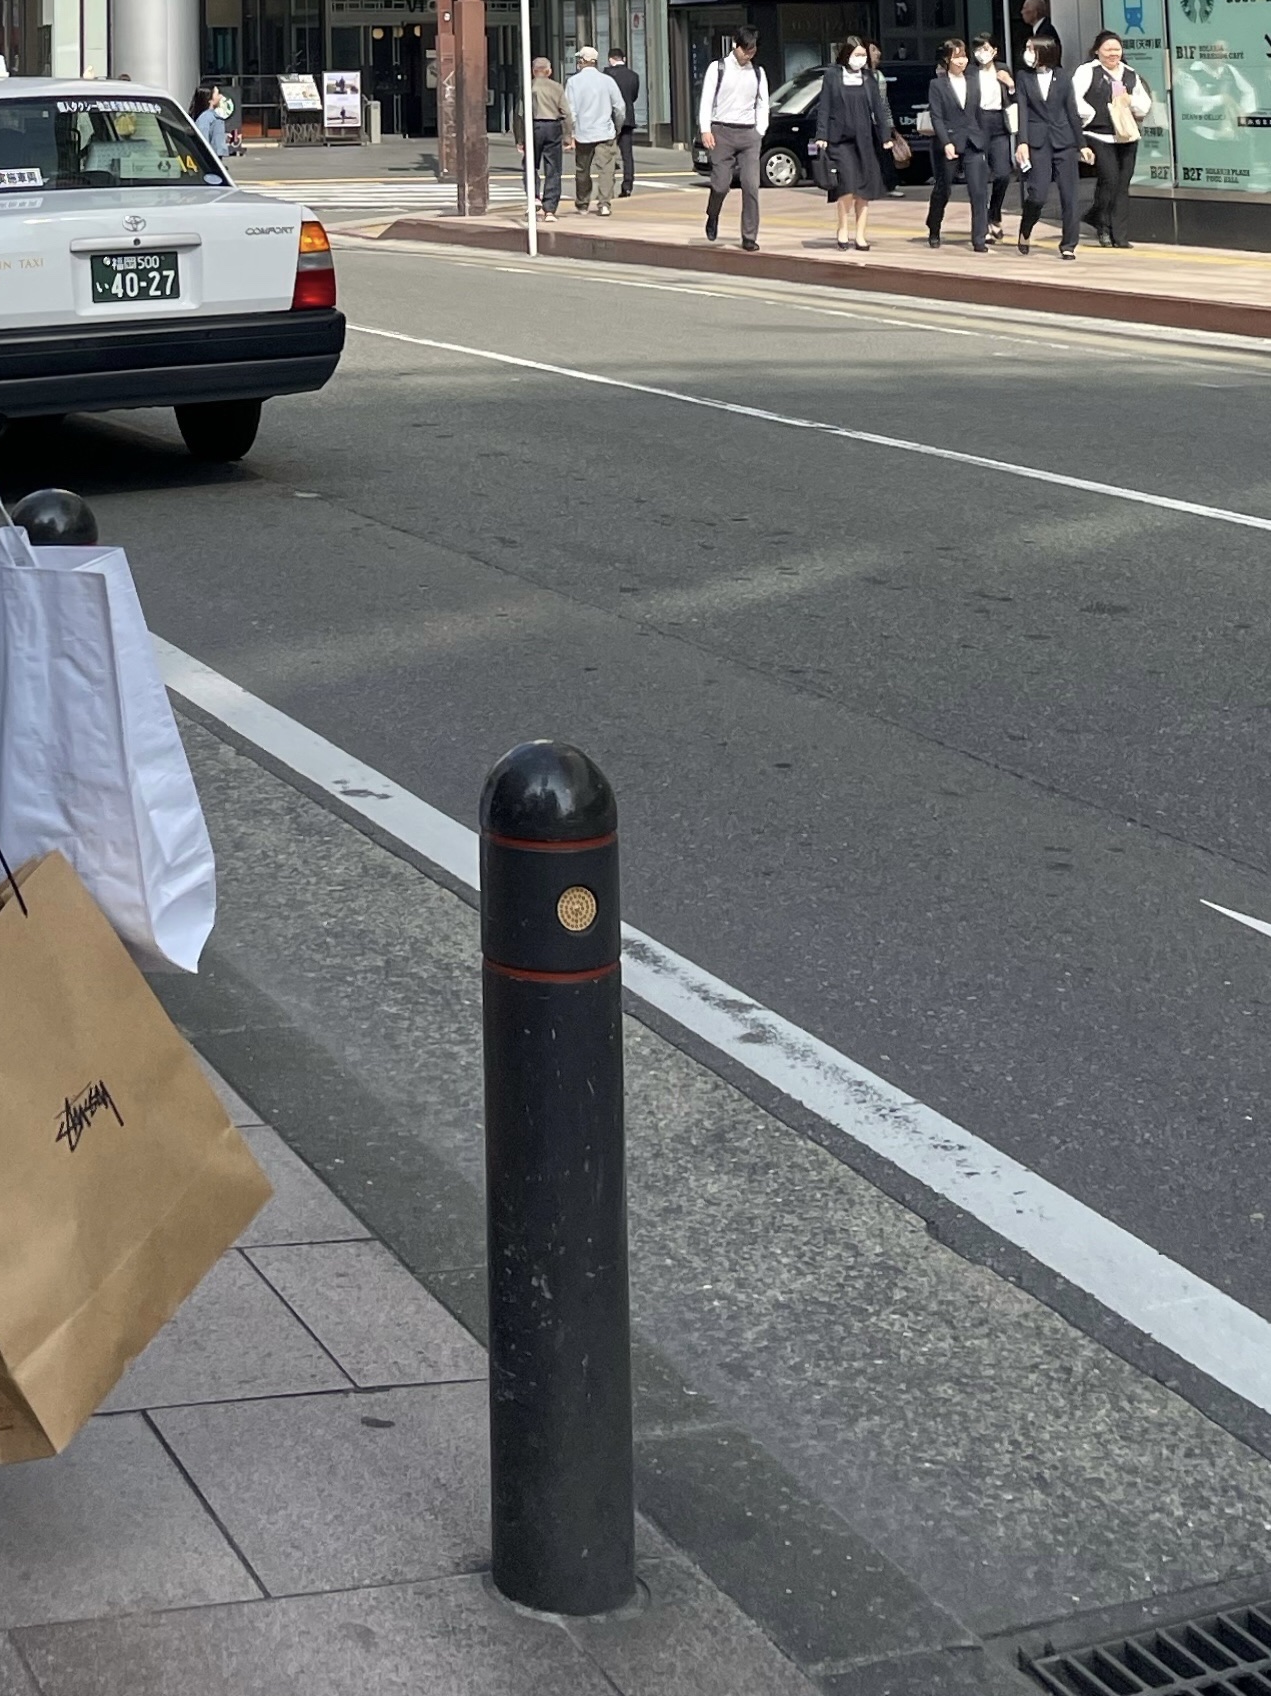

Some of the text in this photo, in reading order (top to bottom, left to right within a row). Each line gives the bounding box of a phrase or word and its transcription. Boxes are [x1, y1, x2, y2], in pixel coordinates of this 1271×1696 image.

[1176, 45, 1196, 60] B1F
[1182, 166, 1203, 182] B2F
[245, 226, 296, 236] COMFORT
[19, 258, 45, 270] TAXI
[111, 255, 160, 271] 福岡 500
[96, 269, 175, 298] い 40-27
